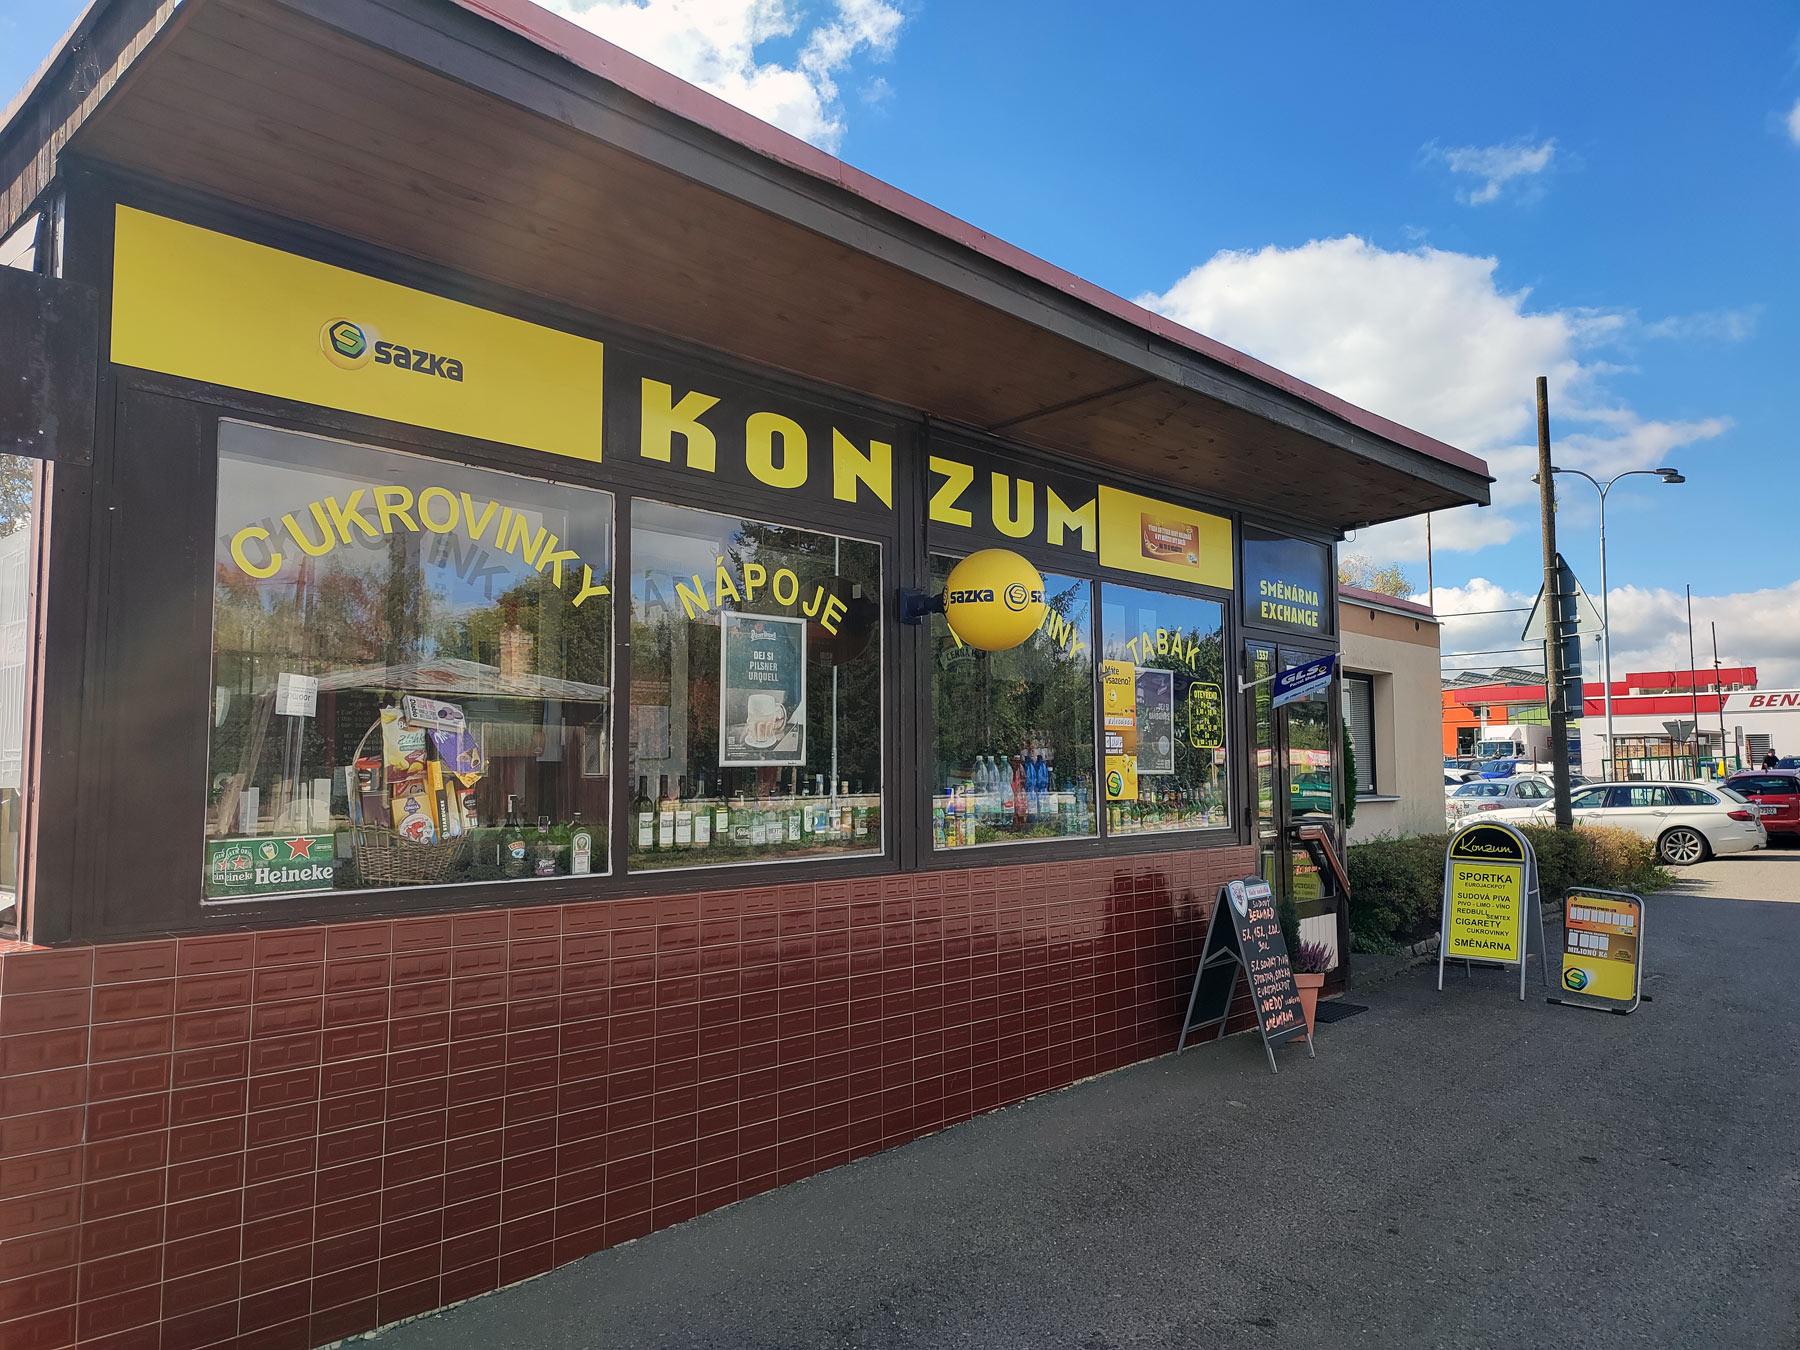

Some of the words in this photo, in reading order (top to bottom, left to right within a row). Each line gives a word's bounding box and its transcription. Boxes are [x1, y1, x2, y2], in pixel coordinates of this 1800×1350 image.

[641, 377, 1096, 553] KONZUM
[231, 486, 610, 607] CUKROVINKY
[675, 556, 847, 636] NÁPOJE
[1260, 580, 1319, 607] SMĚNÁRNA
[1261, 601, 1319, 628] EXCHANGE
[1126, 626, 1200, 671] TABÁK
[753, 651, 765, 660] DEJ
[766, 651, 774, 660] SI
[750, 661, 778, 671] PILSNER
[749, 672, 779, 682] URQUELL
[1281, 665, 1320, 685] GLS
[1749, 694, 1800, 707] BEN
[1459, 836, 1513, 853] Konzum
[1458, 872, 1513, 884] SPORTKA
[1457, 893, 1491, 901] SUDOVÁ
[1492, 894, 1511, 903] PIVA
[1455, 918, 1501, 928] CIGARETY
[1466, 928, 1510, 937] CUKROVINKY
[1454, 938, 1512, 951] SMĚNÁRNA
